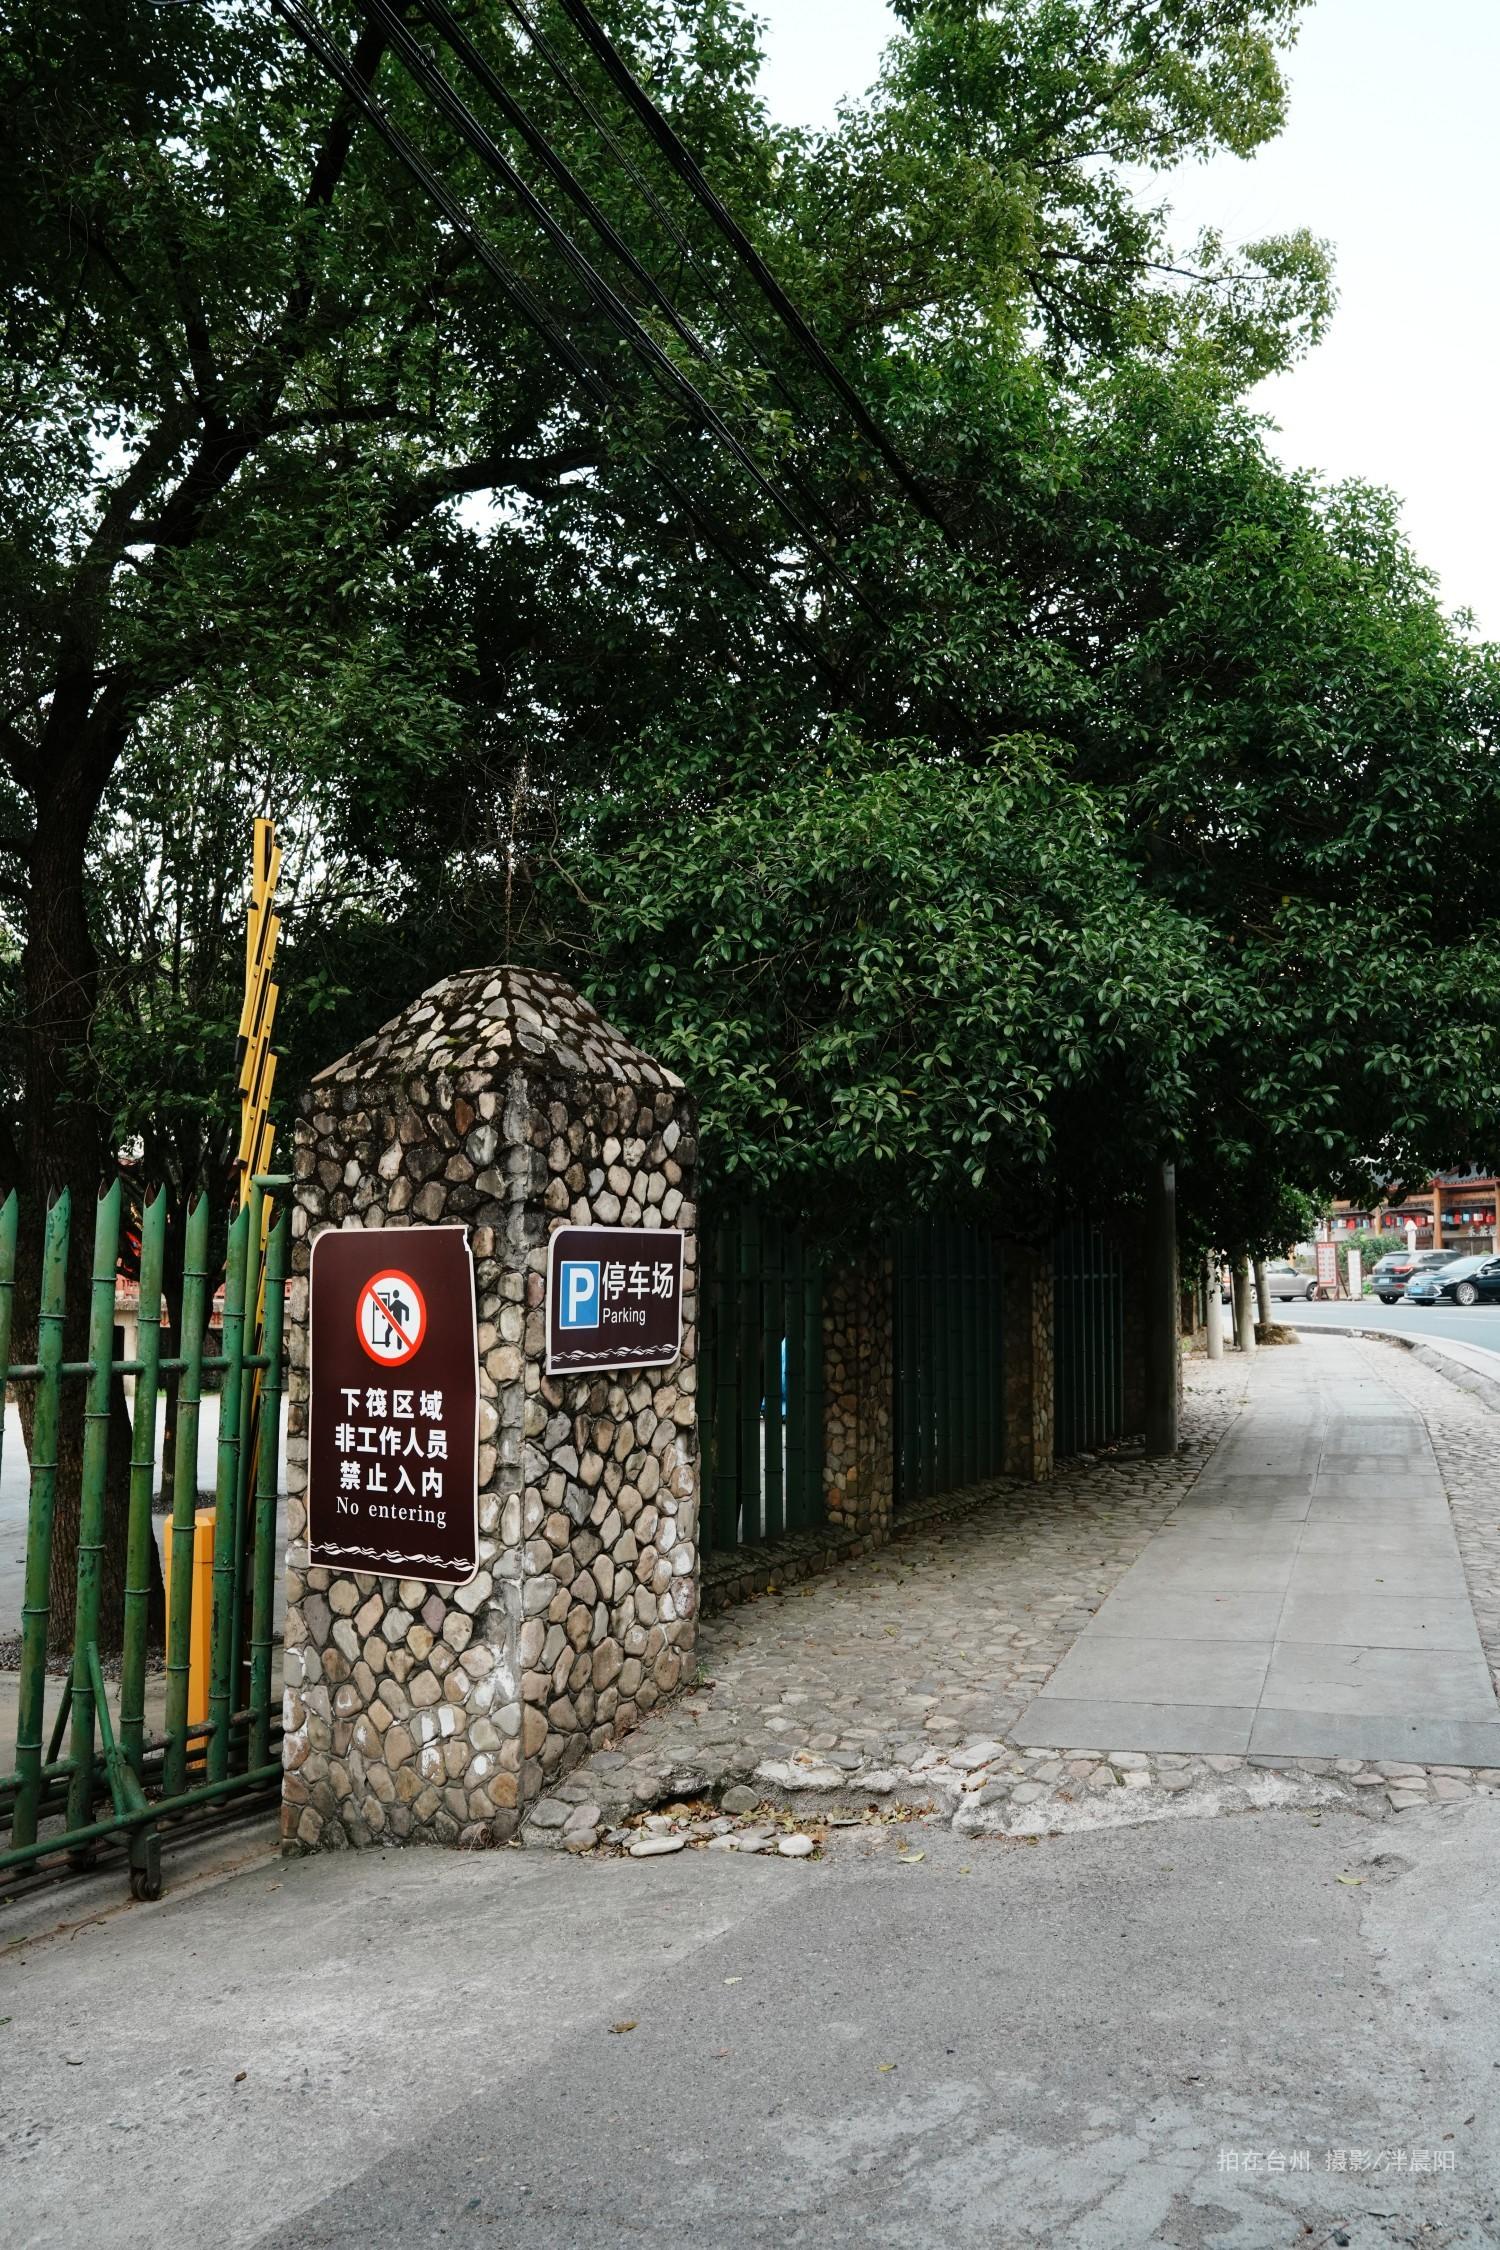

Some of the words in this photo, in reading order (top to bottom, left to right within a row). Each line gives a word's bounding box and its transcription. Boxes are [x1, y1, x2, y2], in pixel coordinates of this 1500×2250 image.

[569, 1267, 595, 1322] P
[602, 1261, 674, 1301] 停车场
[602, 1307, 646, 1326] Parking
[340, 1388, 443, 1421] 下筏区域
[335, 1423, 448, 1461] 非工作人员
[339, 1460, 443, 1499] 禁止入内
[336, 1496, 360, 1515] No
[368, 1503, 447, 1529] entering
